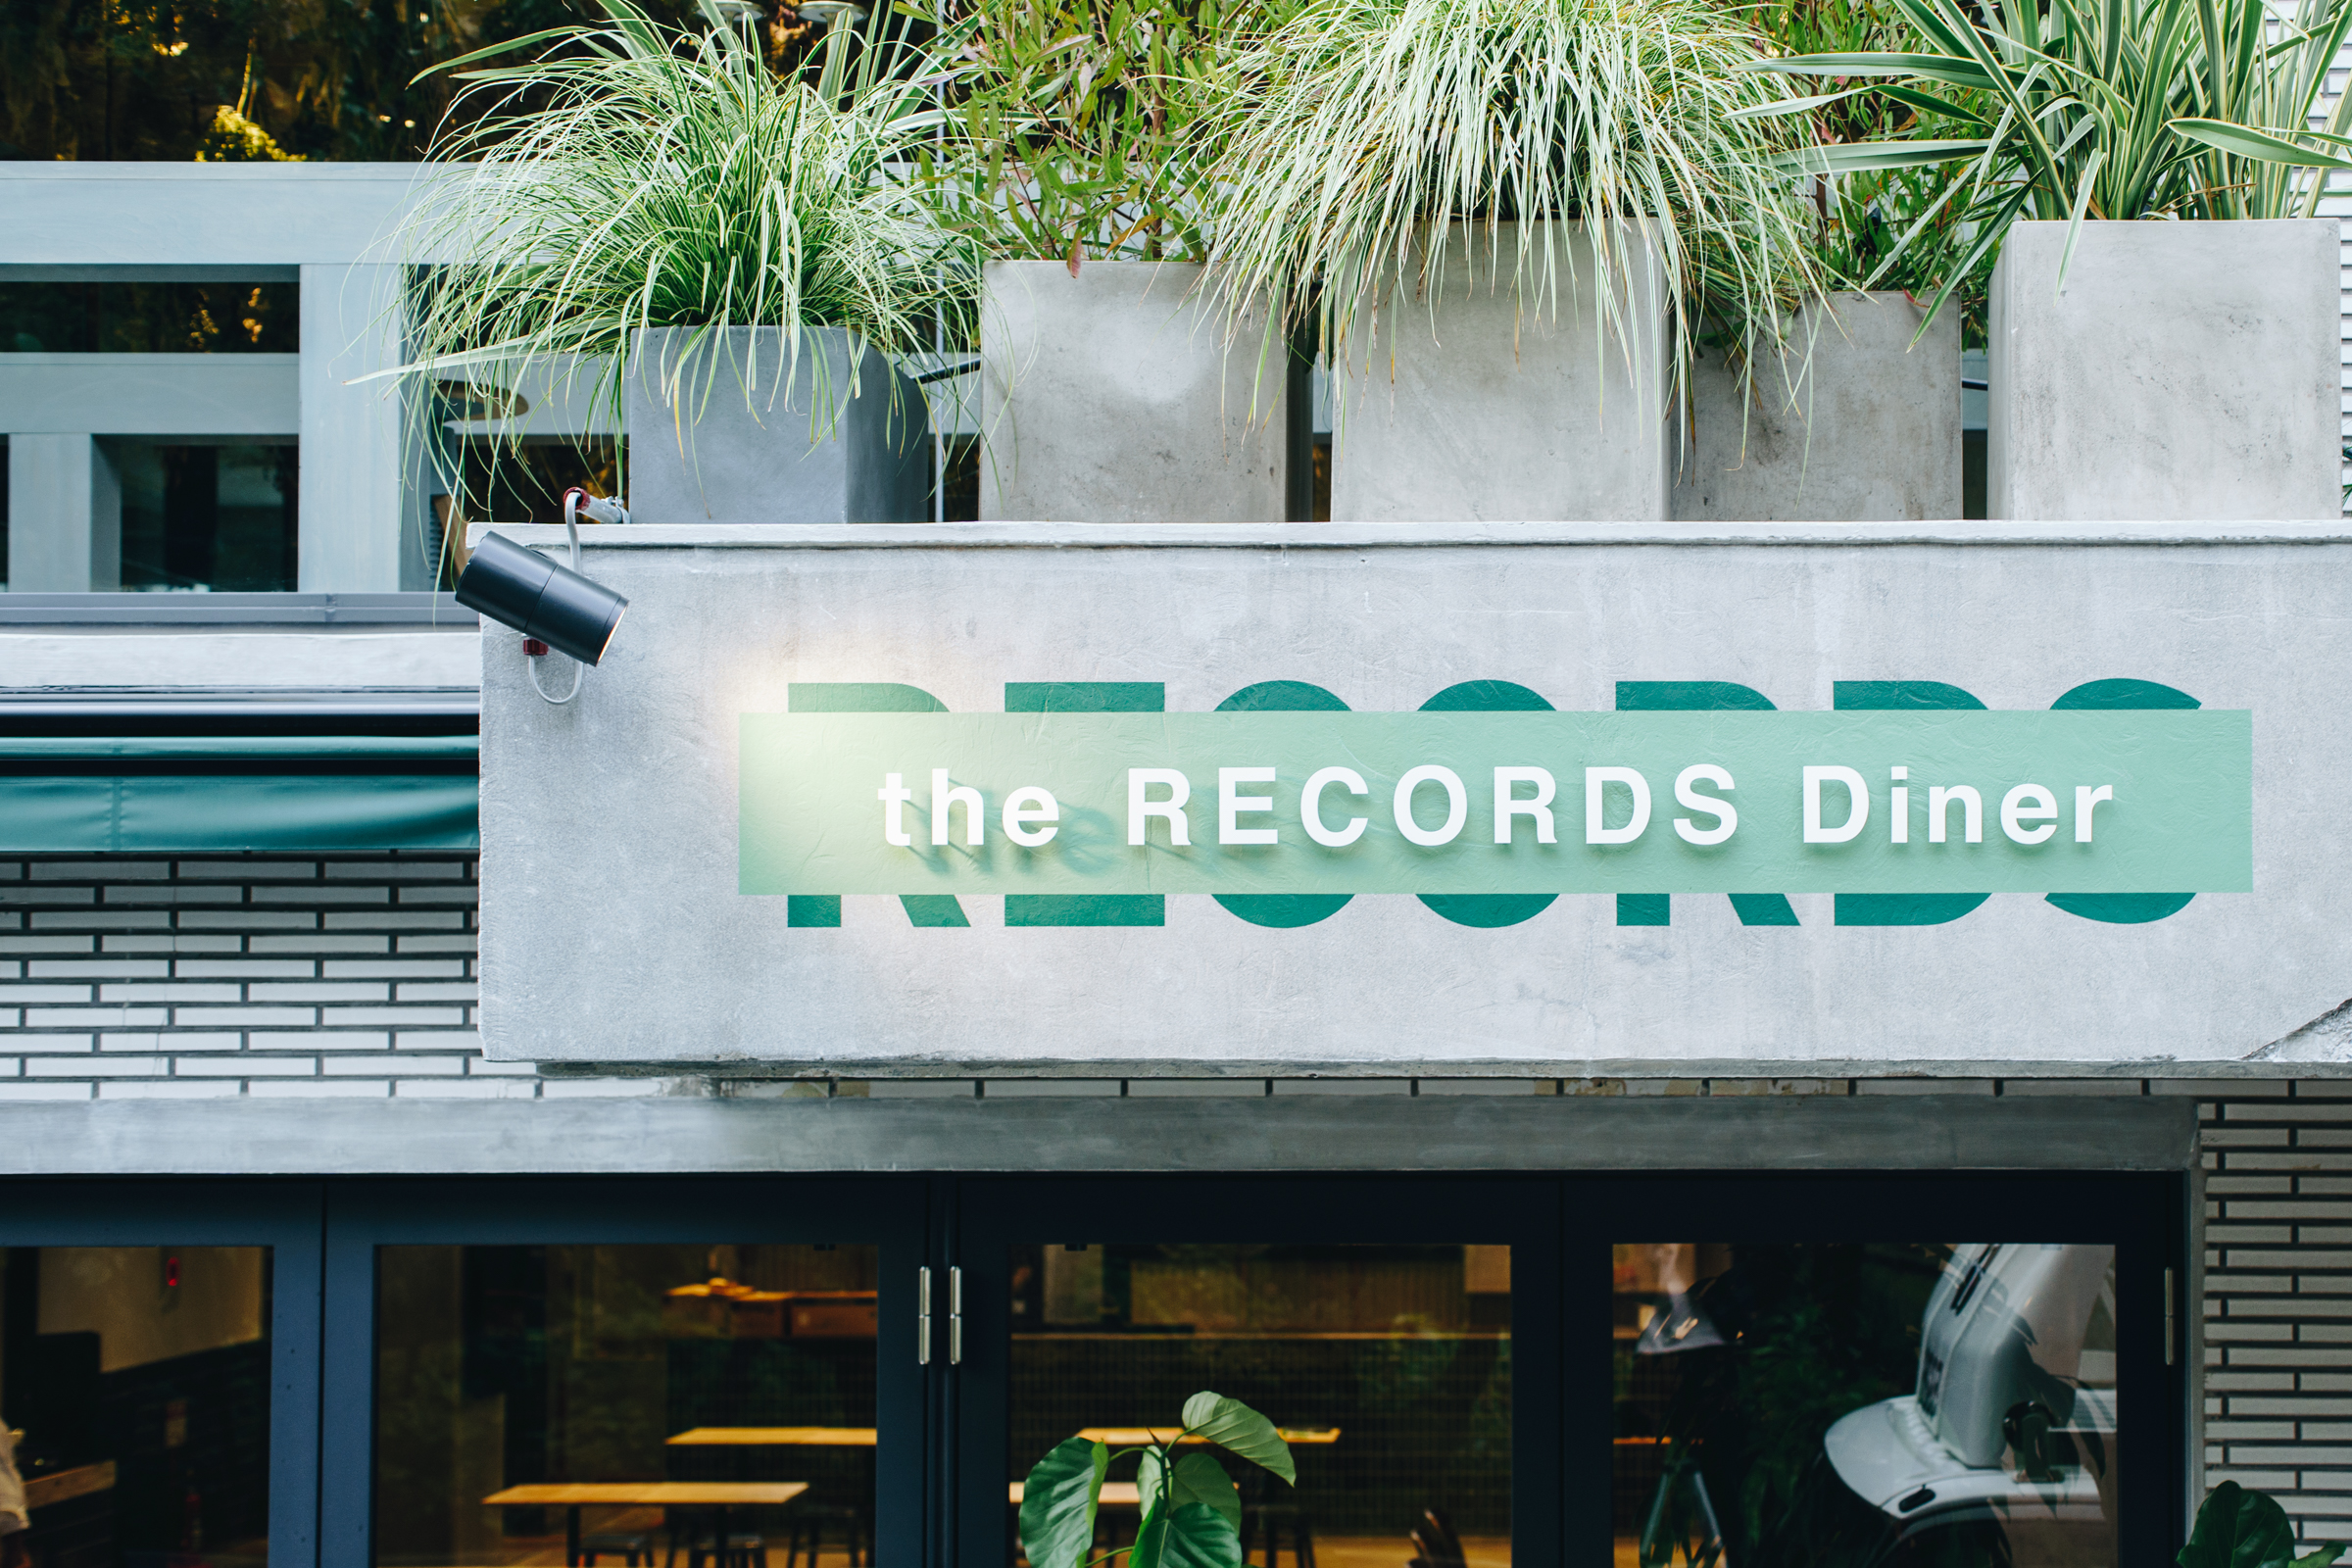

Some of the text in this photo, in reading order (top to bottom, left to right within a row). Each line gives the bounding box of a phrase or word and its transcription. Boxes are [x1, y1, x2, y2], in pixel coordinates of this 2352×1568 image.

[877, 763, 2114, 849] the RECORDS Diner
